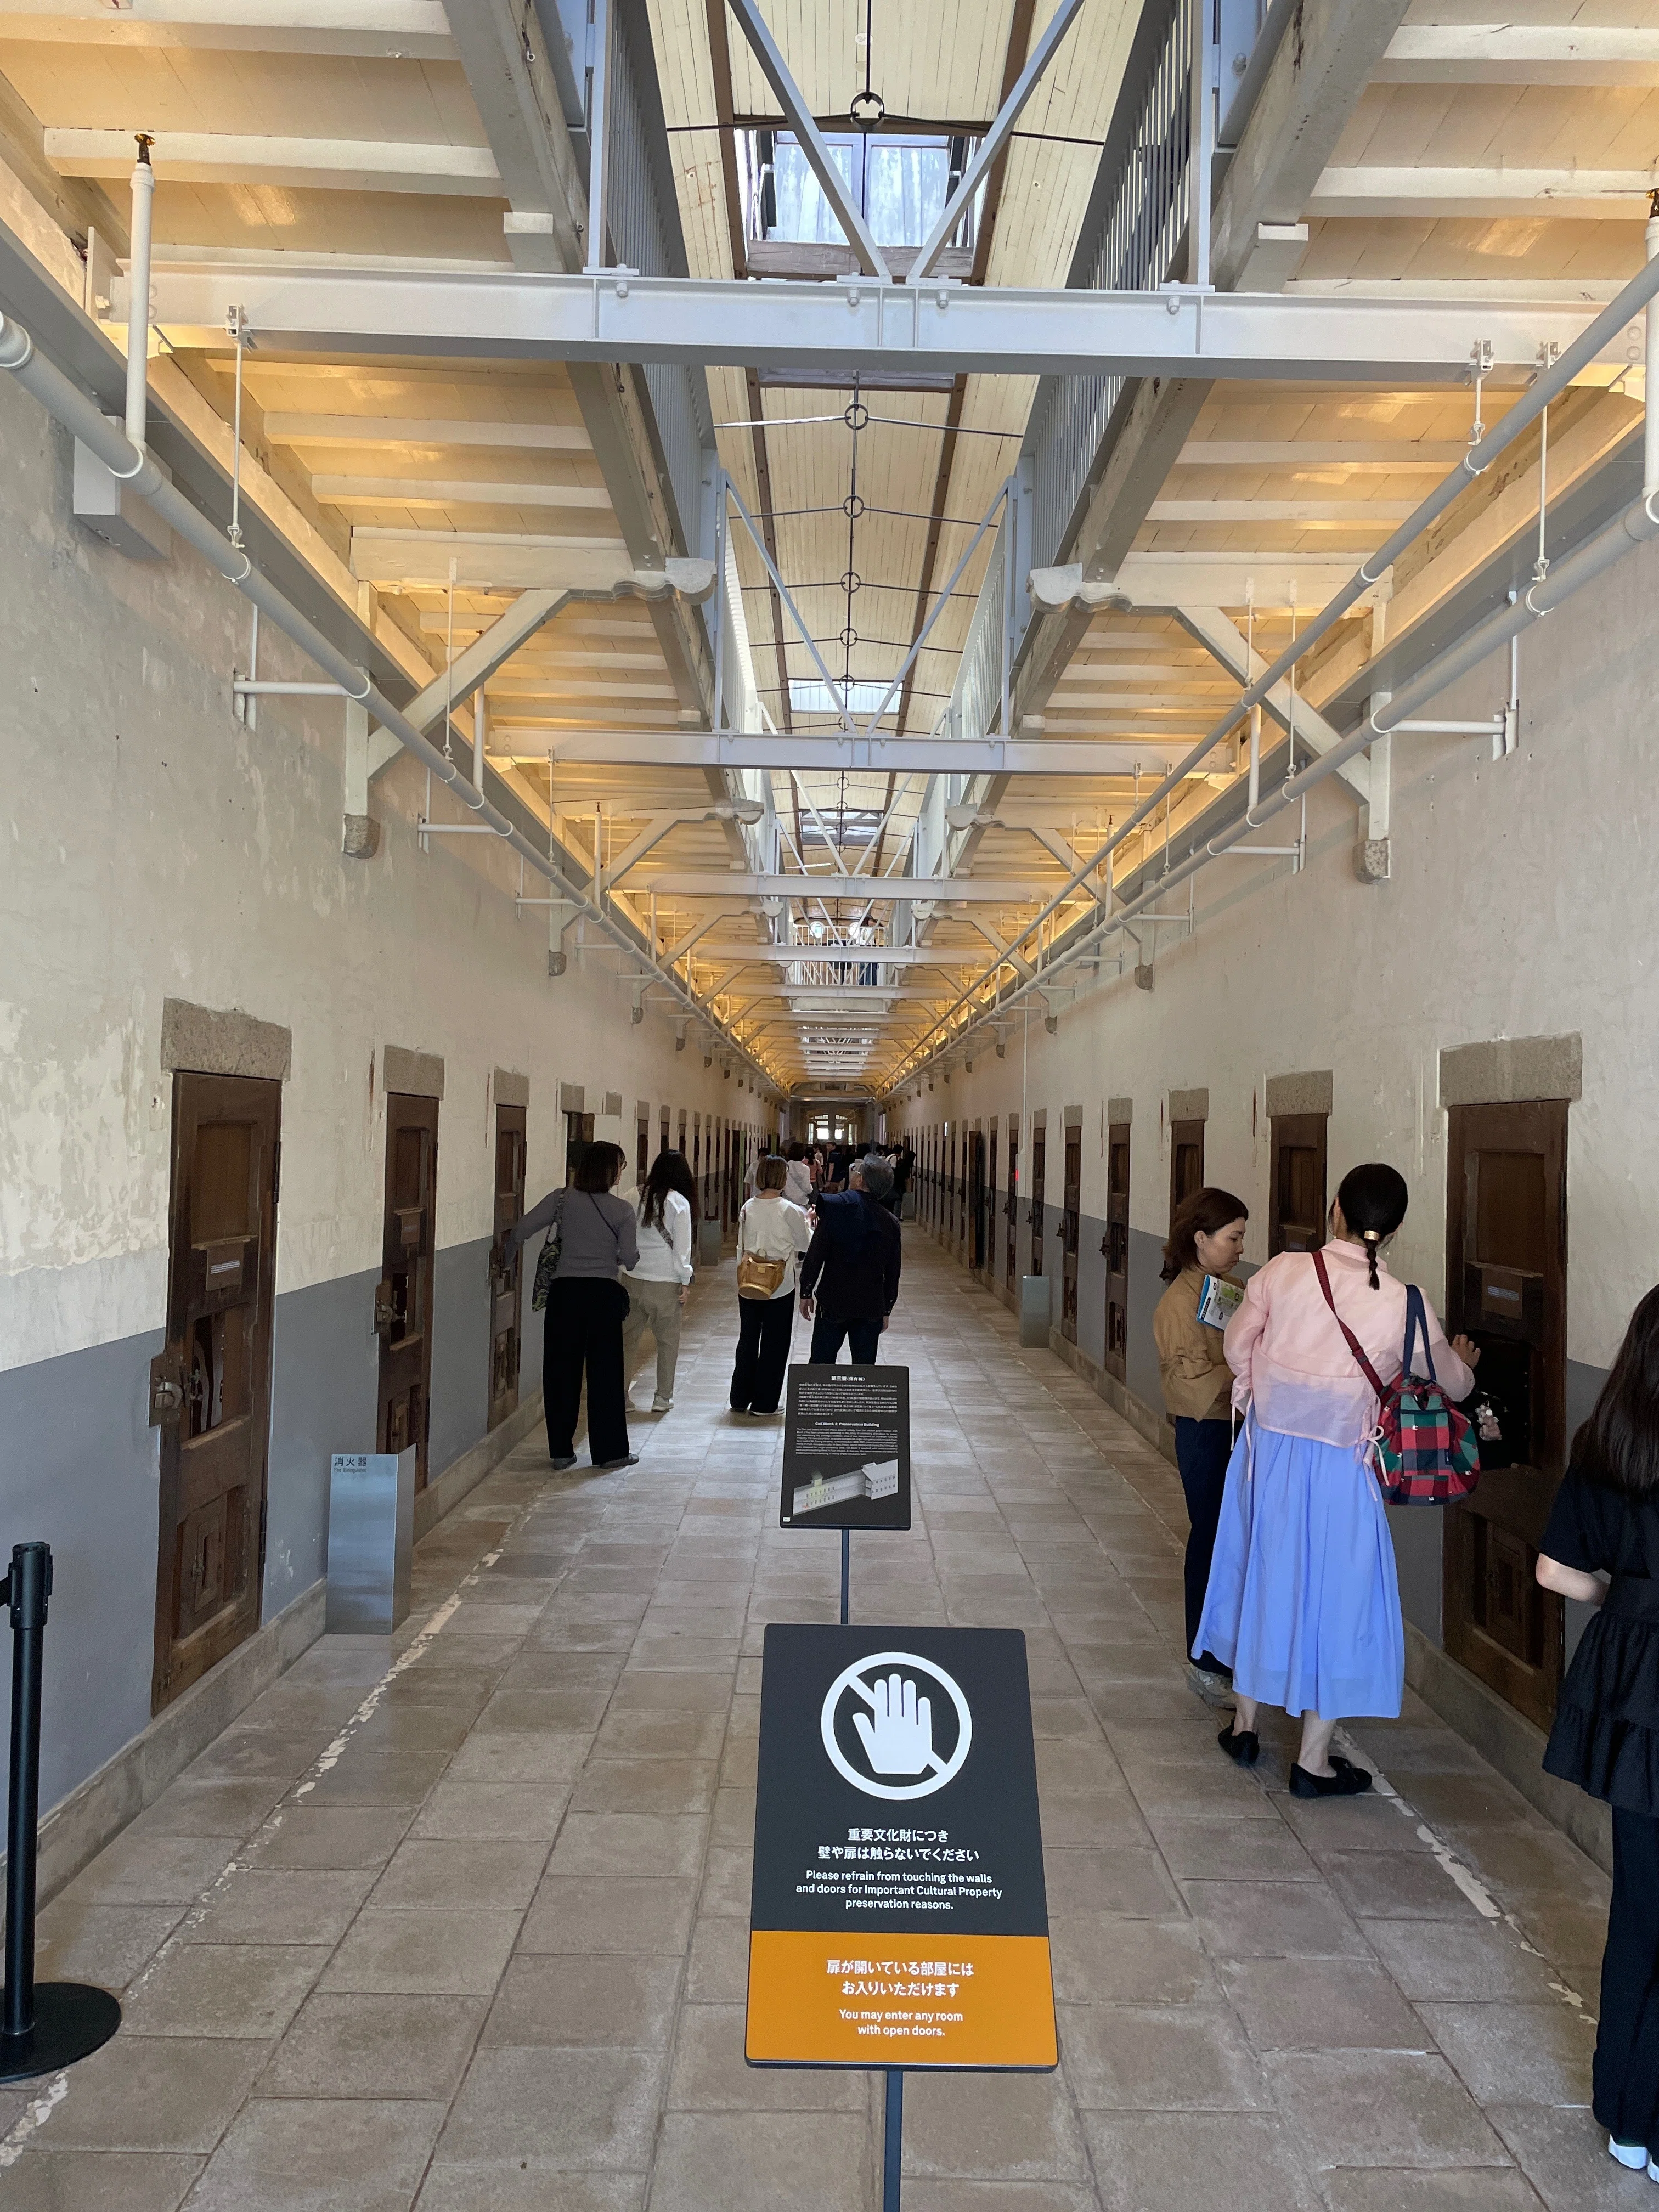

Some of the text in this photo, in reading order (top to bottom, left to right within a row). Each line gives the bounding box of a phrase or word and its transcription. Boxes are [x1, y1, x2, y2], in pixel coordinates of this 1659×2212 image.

[334, 1457, 367, 1466] 消火器
[848, 1827, 949, 1843] 重要文化財につき
[817, 1846, 979, 1862] 壁や扉は触らないでください
[806, 1870, 992, 1884] Please refrain from touching the walls
[795, 1883, 1003, 1899] and doors for Important Cultural Property
[845, 1899, 953, 1910] preservation reasons.
[827, 1959, 974, 1976] 扉が開いている部屋には
[842, 1980, 960, 1997] お入りいただけます
[839, 2008, 963, 2023] You may enter any room
[857, 2024, 945, 2038] with open doors.
